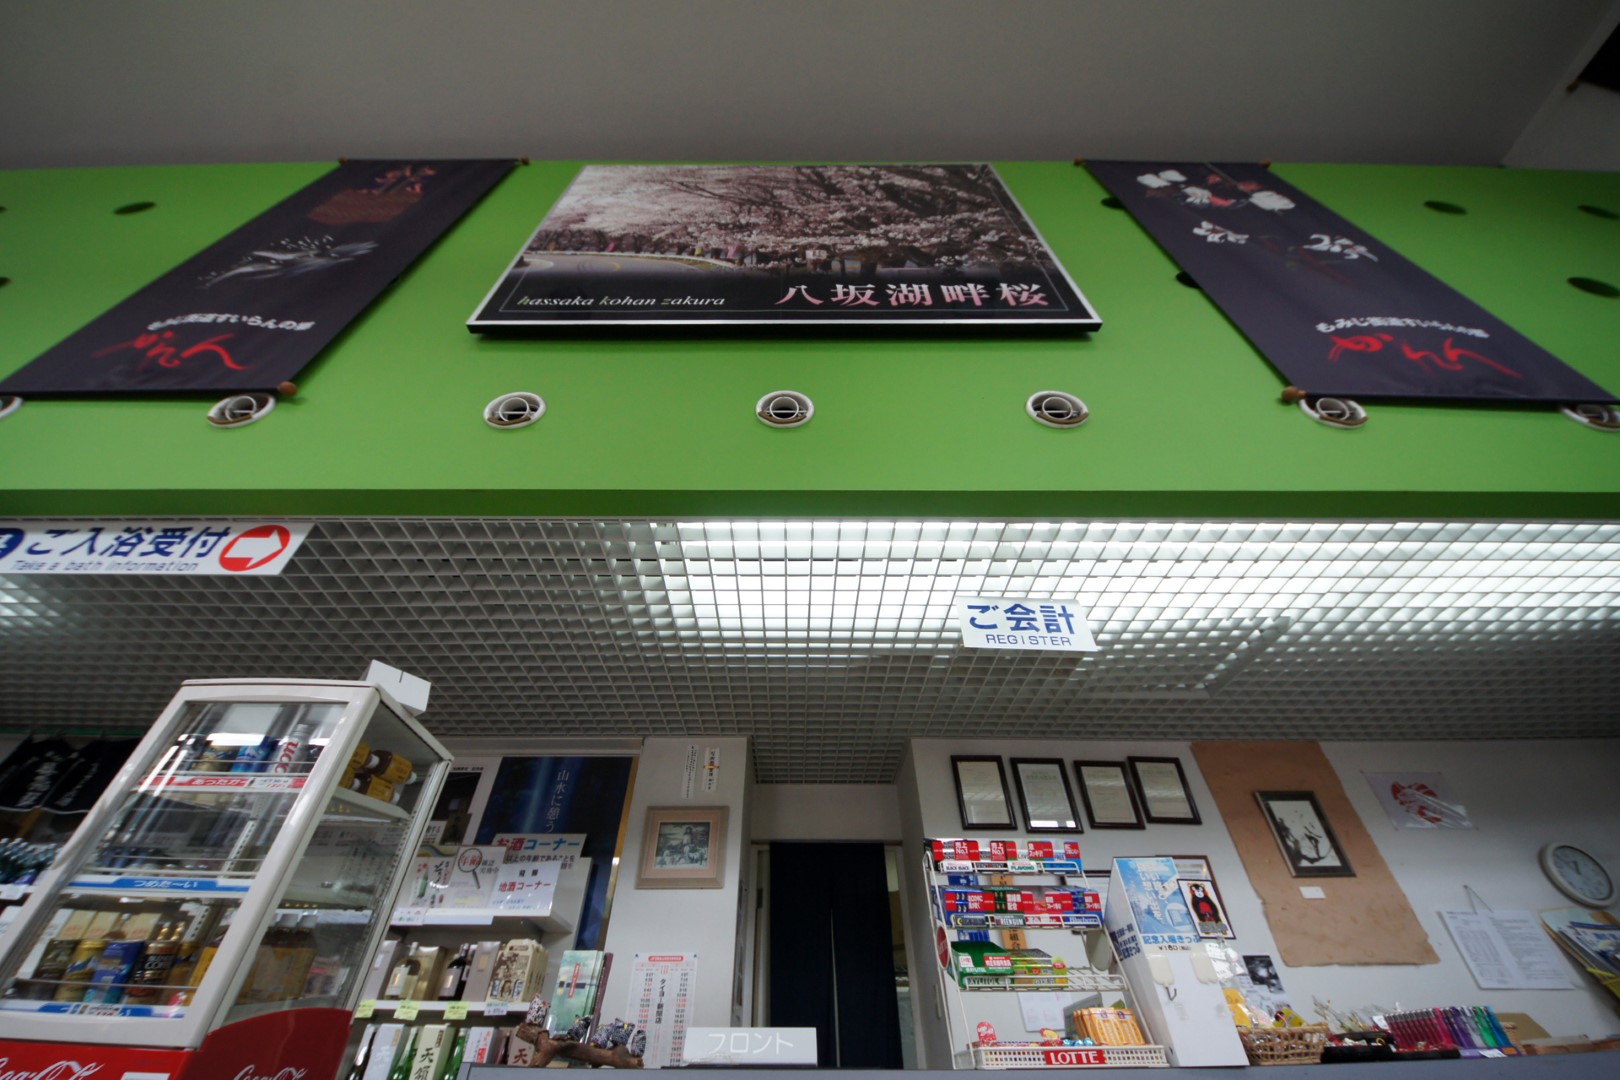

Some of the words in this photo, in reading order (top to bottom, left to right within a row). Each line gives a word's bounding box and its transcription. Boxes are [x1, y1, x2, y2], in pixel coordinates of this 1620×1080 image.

[517, 296, 594, 306] hassaka
[600, 296, 656, 306] kohan
[661, 296, 725, 306] zakura
[774, 284, 1049, 307] 八坂湖畔桜
[25, 526, 231, 557] ご入浴受付
[11, 560, 46, 571] Take
[63, 560, 103, 571] bath
[104, 560, 199, 571] information
[967, 603, 1075, 634] ご会計
[986, 634, 1072, 646] REGISTER
[968, 977, 998, 985] XYLITOL
[708, 1032, 794, 1055] フロント
[1050, 1052, 1099, 1064] LOTTE
